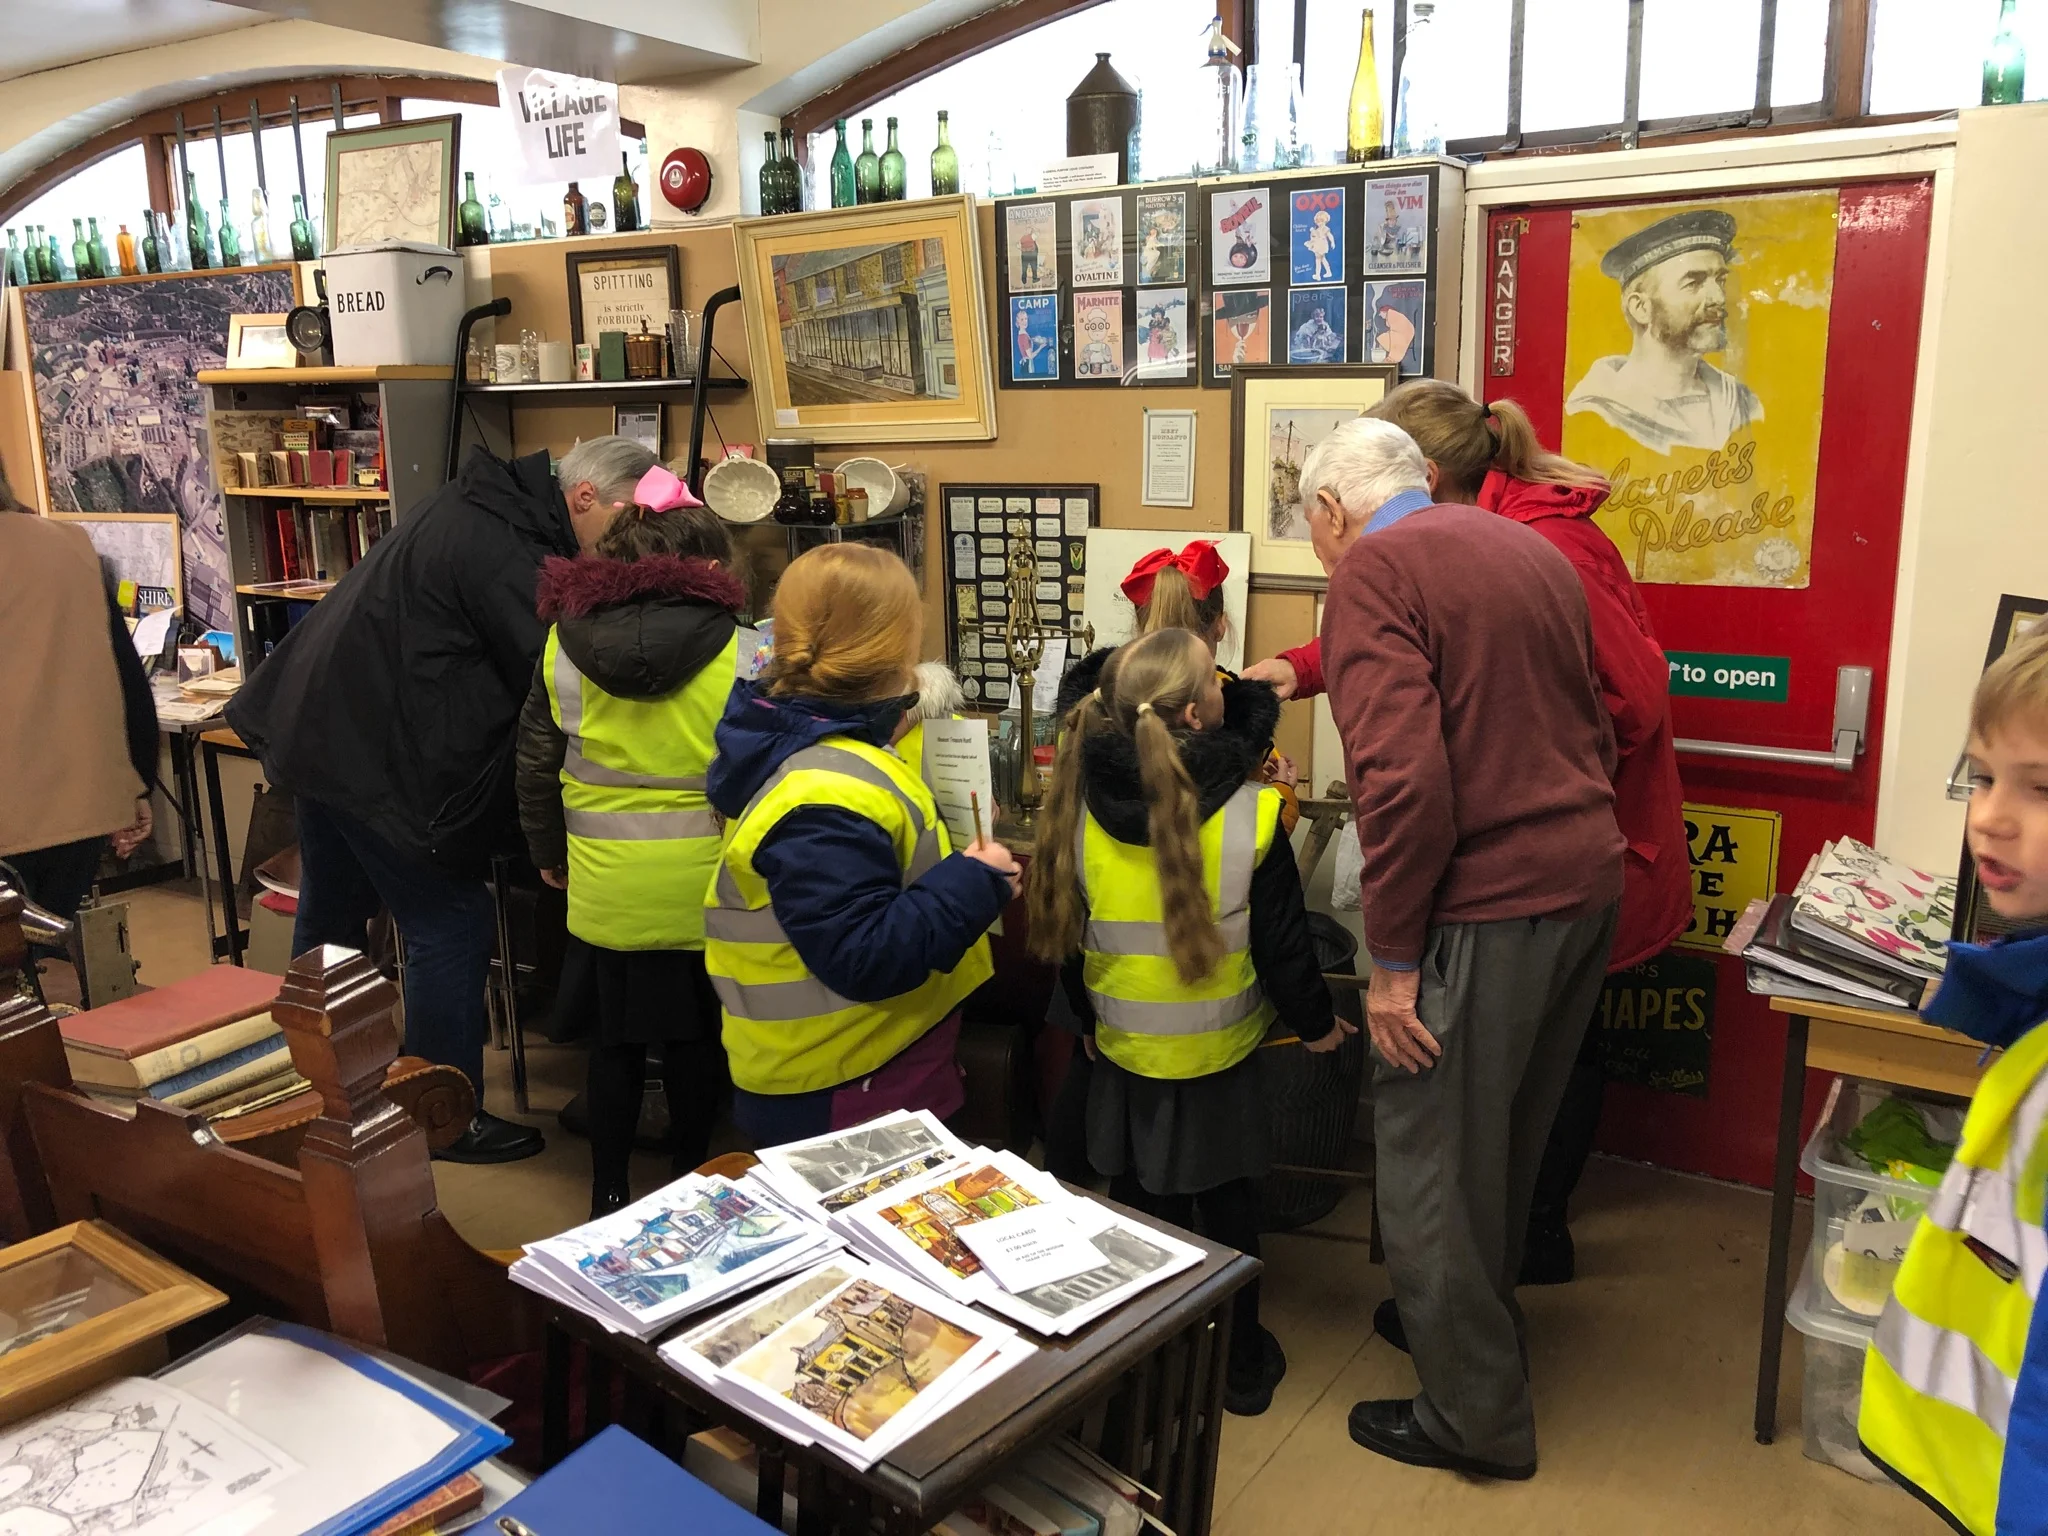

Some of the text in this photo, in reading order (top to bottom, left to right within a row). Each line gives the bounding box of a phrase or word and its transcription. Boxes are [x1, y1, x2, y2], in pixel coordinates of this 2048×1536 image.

[545, 122, 586, 159] LIFE
[1296, 192, 1341, 211] OXO
[1397, 195, 1424, 210] VIM
[1008, 206, 1054, 220] ANDREWS
[1368, 262, 1392, 270] CLEANSER
[1396, 261, 1422, 269] POLISHER
[593, 273, 653, 291] SPITTTING
[1075, 271, 1120, 283] OVALTINE
[337, 291, 385, 313] BREAD
[604, 304, 611, 312] is
[1018, 298, 1049, 309] CAMP
[1077, 296, 1119, 314] MARMITE
[1493, 238, 1515, 364] DANGER
[1084, 322, 1110, 331] GOOD
[1600, 441, 1757, 514] layer's
[1629, 491, 1796, 580] Please
[1682, 664, 1776, 689] to open
[1690, 869, 1724, 897] E
[996, 1227, 1036, 1244] LOCAL CARDS
